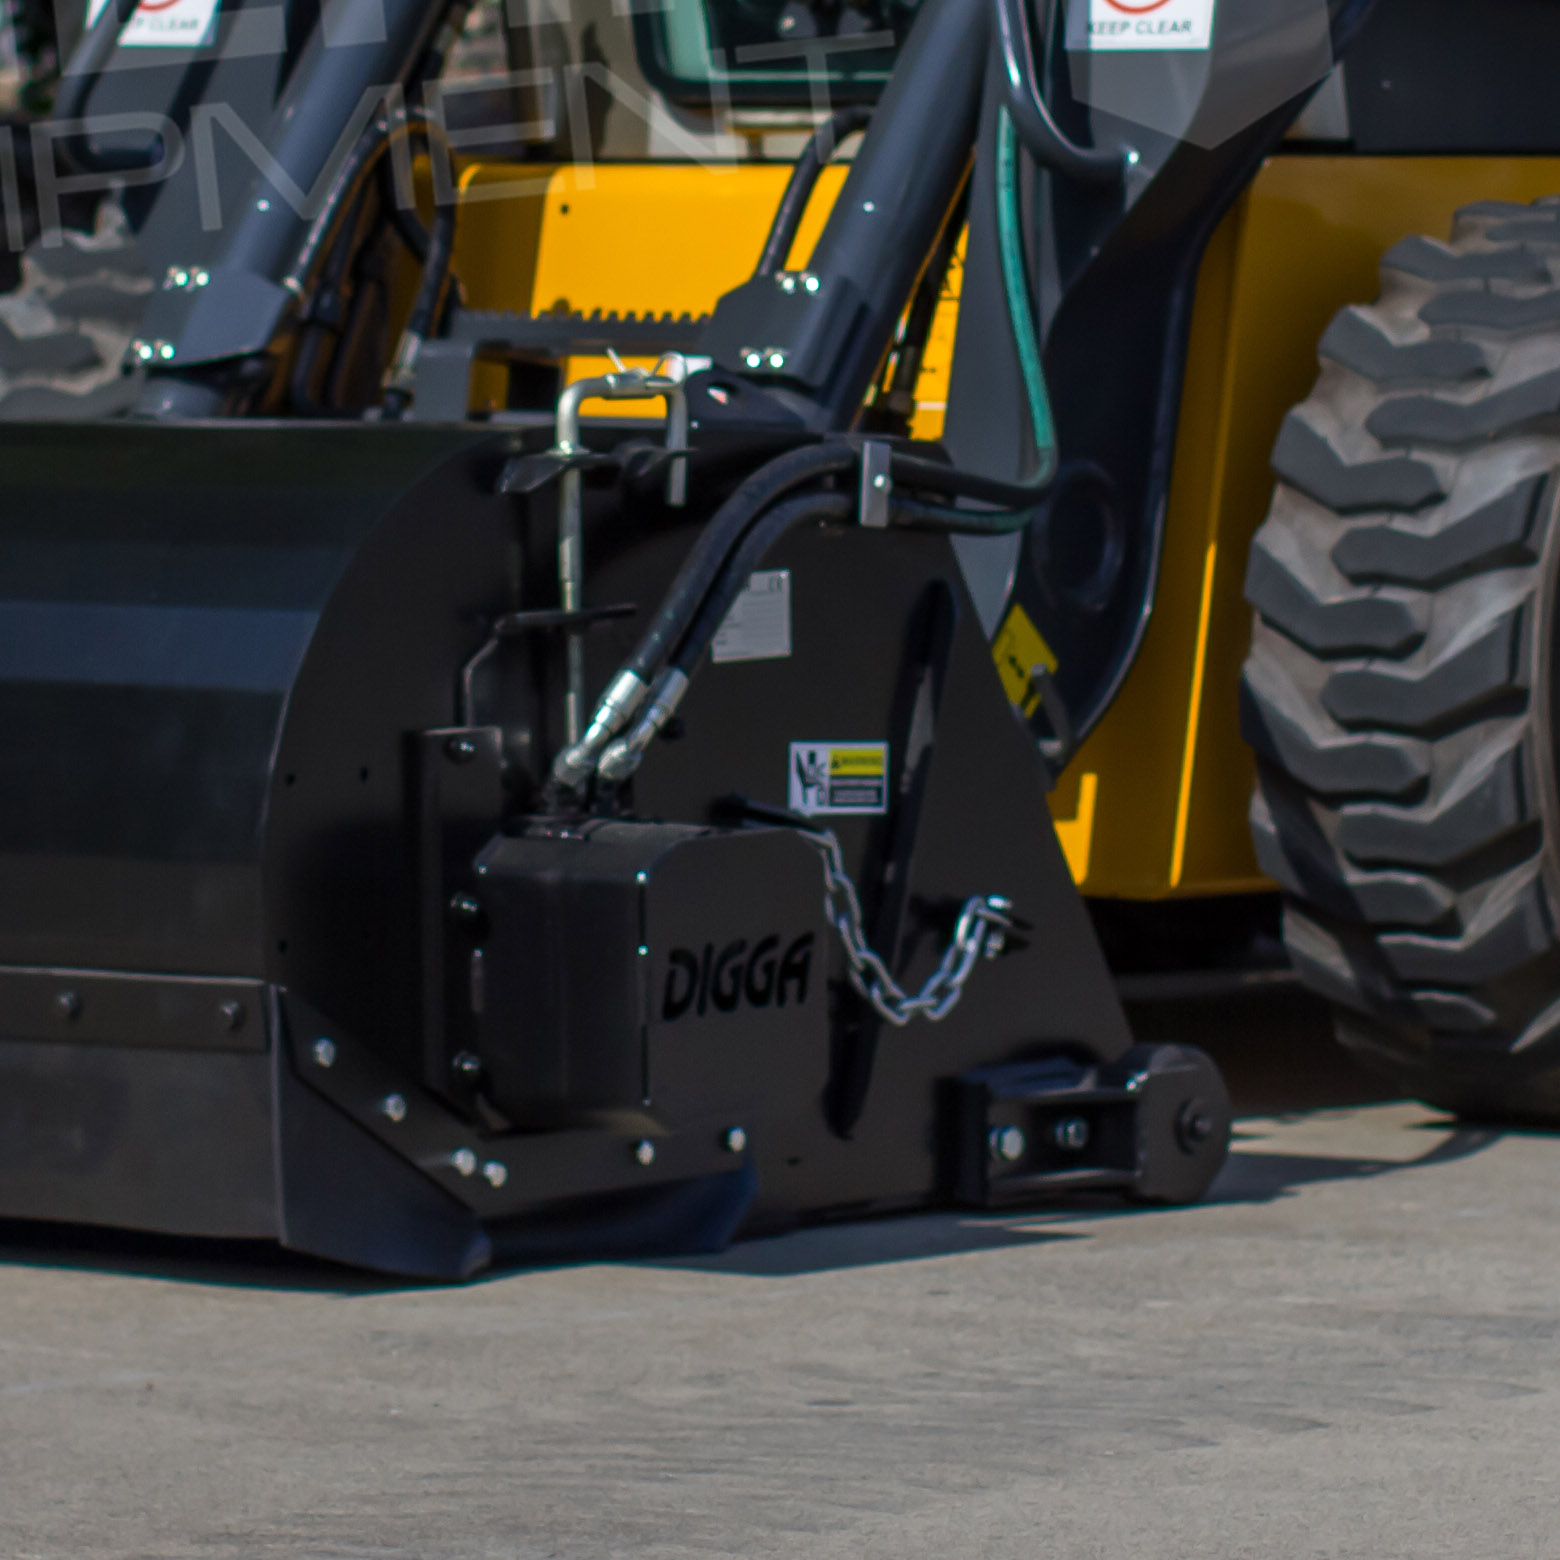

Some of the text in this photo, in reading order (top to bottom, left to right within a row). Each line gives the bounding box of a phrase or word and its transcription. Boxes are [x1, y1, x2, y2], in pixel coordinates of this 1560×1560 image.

[1086, 18, 1192, 35] KEEP CLEAR
[661, 930, 815, 1022] DIGGA
